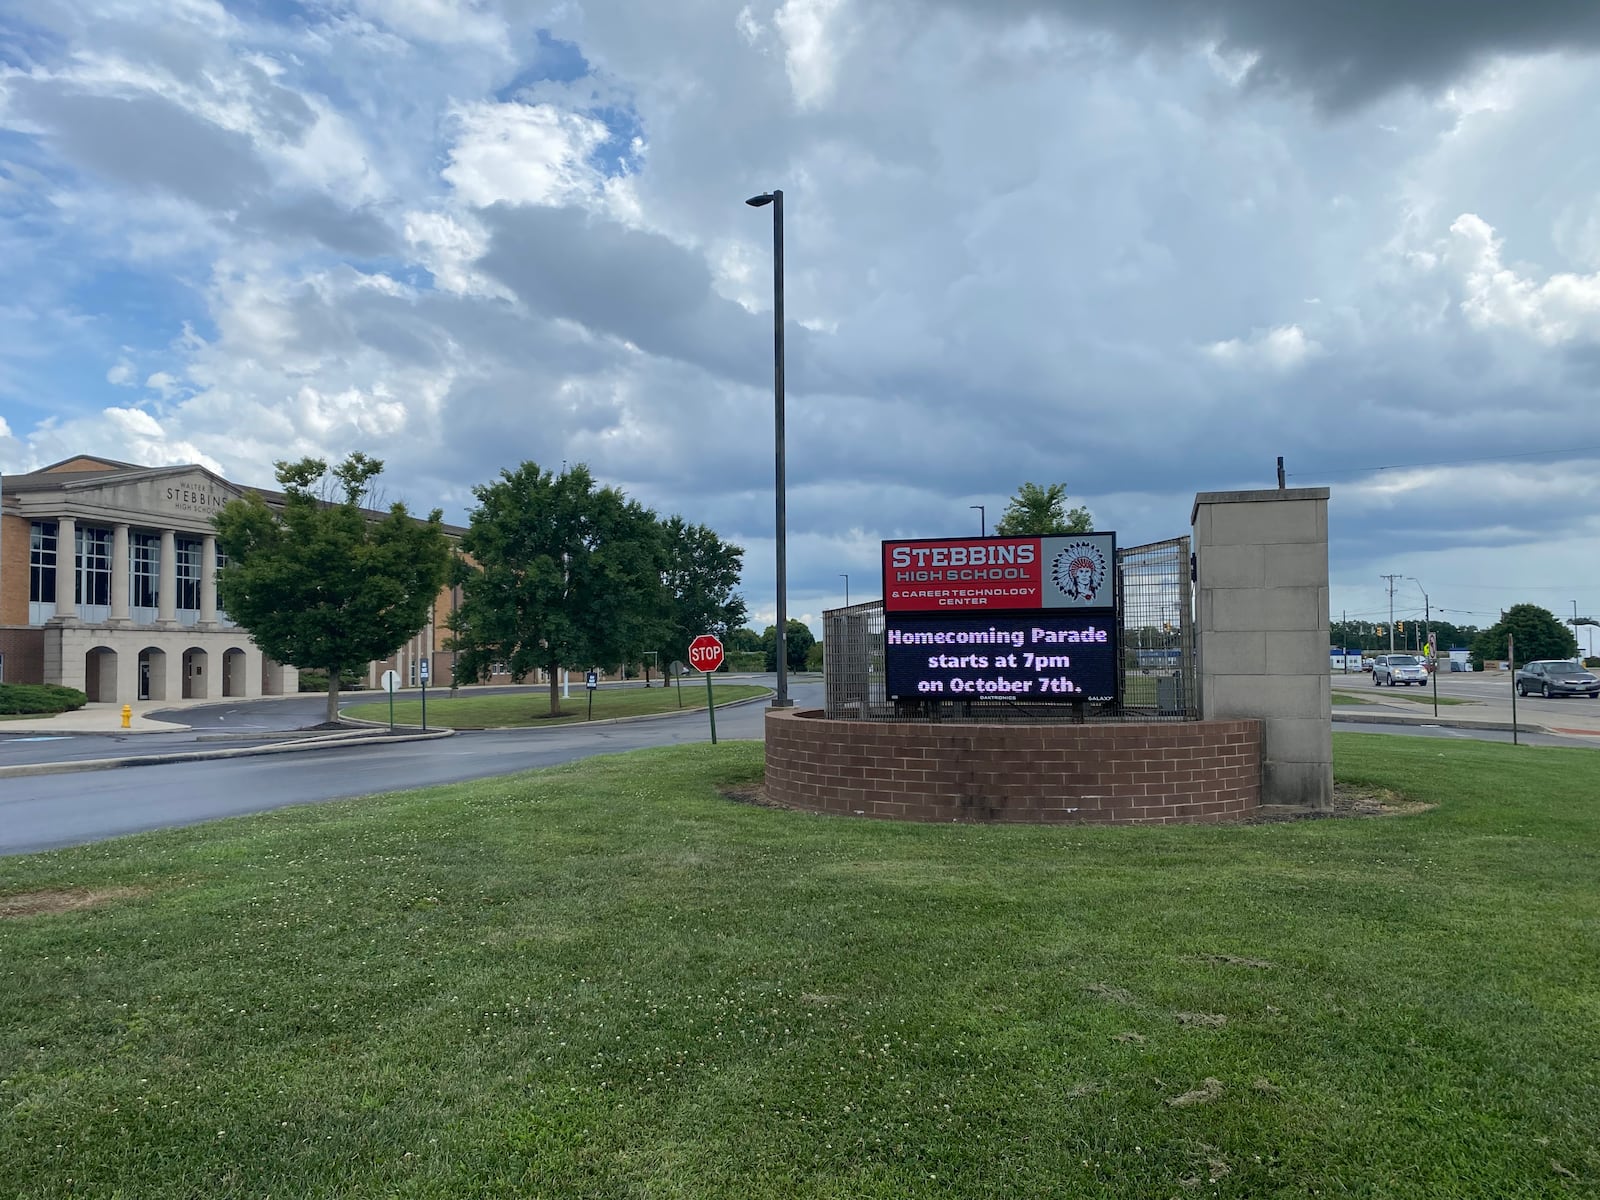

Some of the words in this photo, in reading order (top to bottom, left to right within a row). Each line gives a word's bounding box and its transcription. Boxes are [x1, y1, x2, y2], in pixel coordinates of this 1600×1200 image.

[167, 488, 229, 508] STEBBINS
[175, 503, 192, 512] HIGH
[892, 544, 1035, 568] STEBBINS
[896, 570, 943, 582] HIGH
[946, 567, 1031, 581] SCHOOL
[901, 590, 950, 598] CAREER
[951, 588, 1036, 597] TECHNOLOGY
[887, 626, 1025, 647] Homecoming
[1031, 626, 1108, 643] Parade
[692, 646, 720, 662] STOP
[928, 653, 989, 668] starts
[994, 653, 1018, 668] at
[1022, 652, 1070, 671] 7pm
[917, 680, 943, 692] on
[949, 676, 1033, 692] October
[1038, 676, 1082, 692] 7th.
